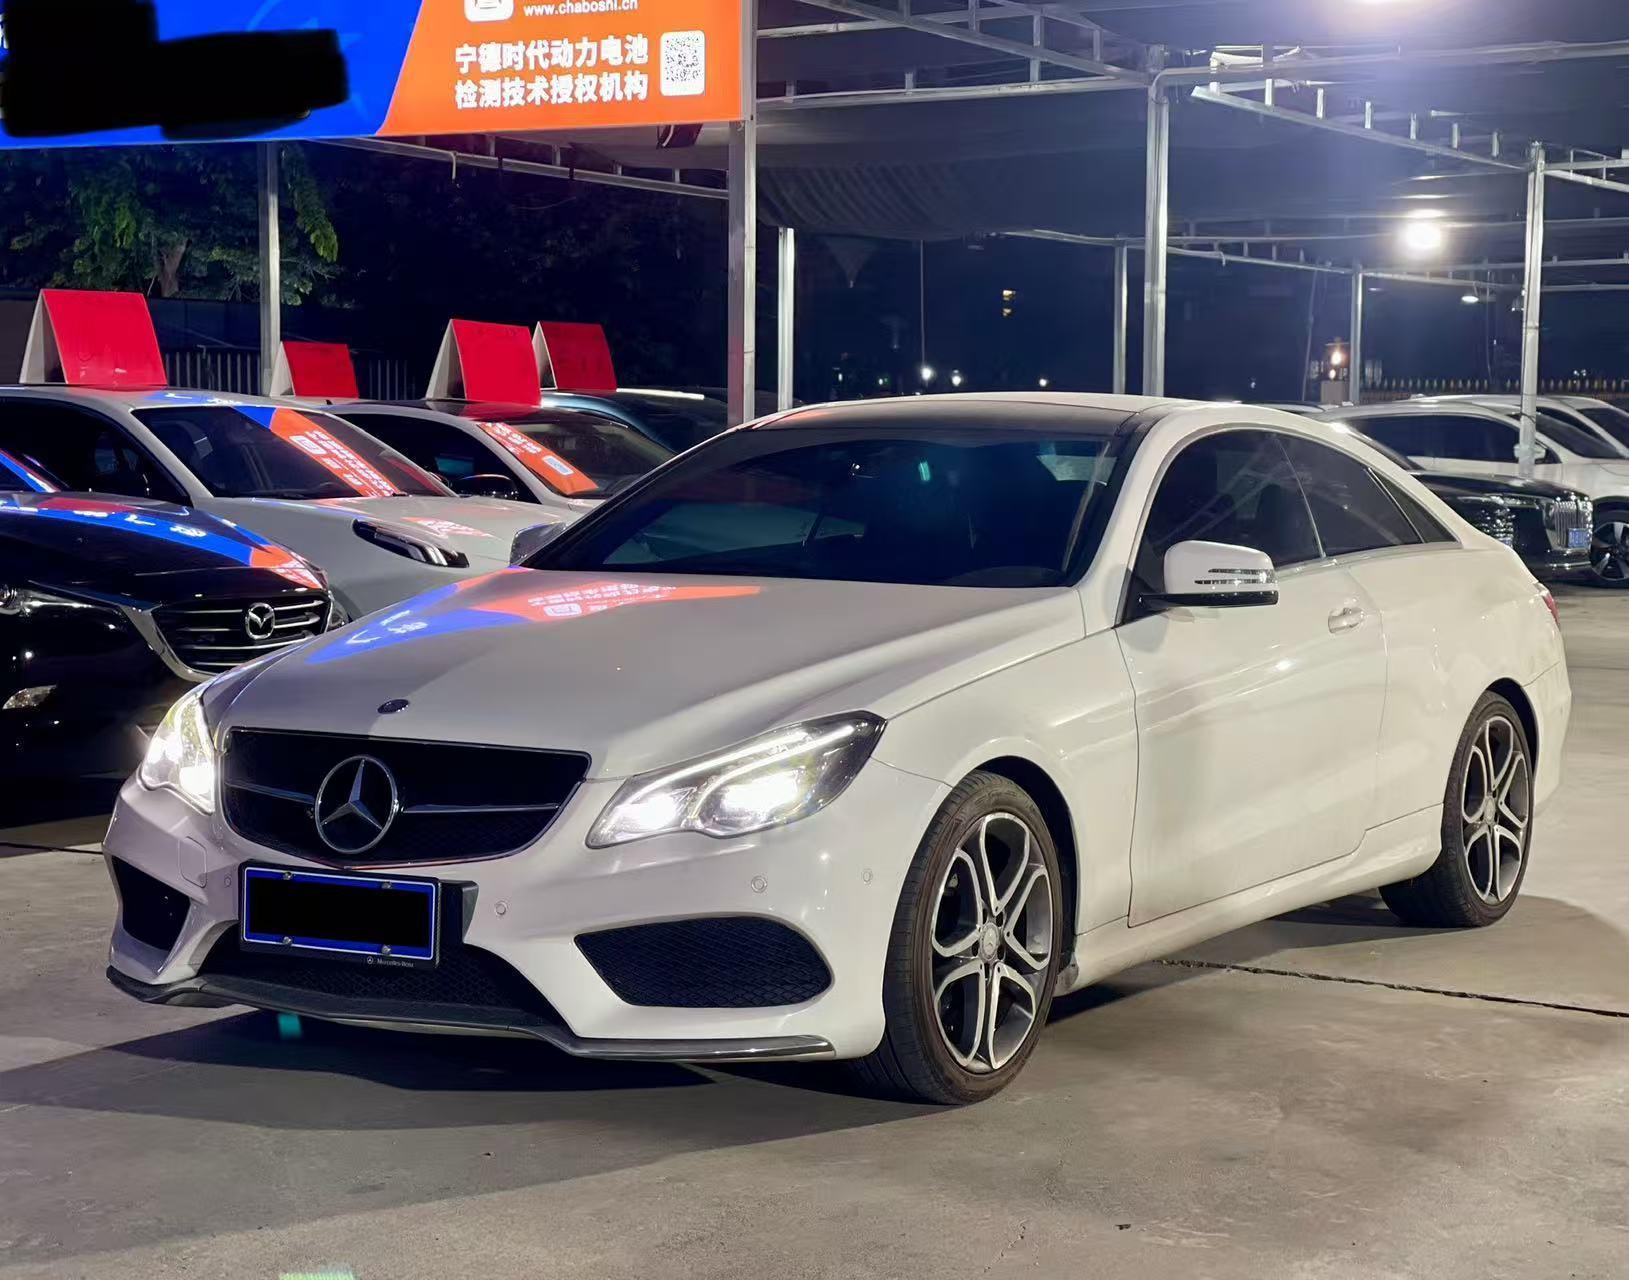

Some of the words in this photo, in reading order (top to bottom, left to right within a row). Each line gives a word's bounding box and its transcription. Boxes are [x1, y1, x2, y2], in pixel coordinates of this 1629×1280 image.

[455, 33, 648, 74] 宁德时代动力电池
[455, 70, 648, 109] 检测技术授权机构
